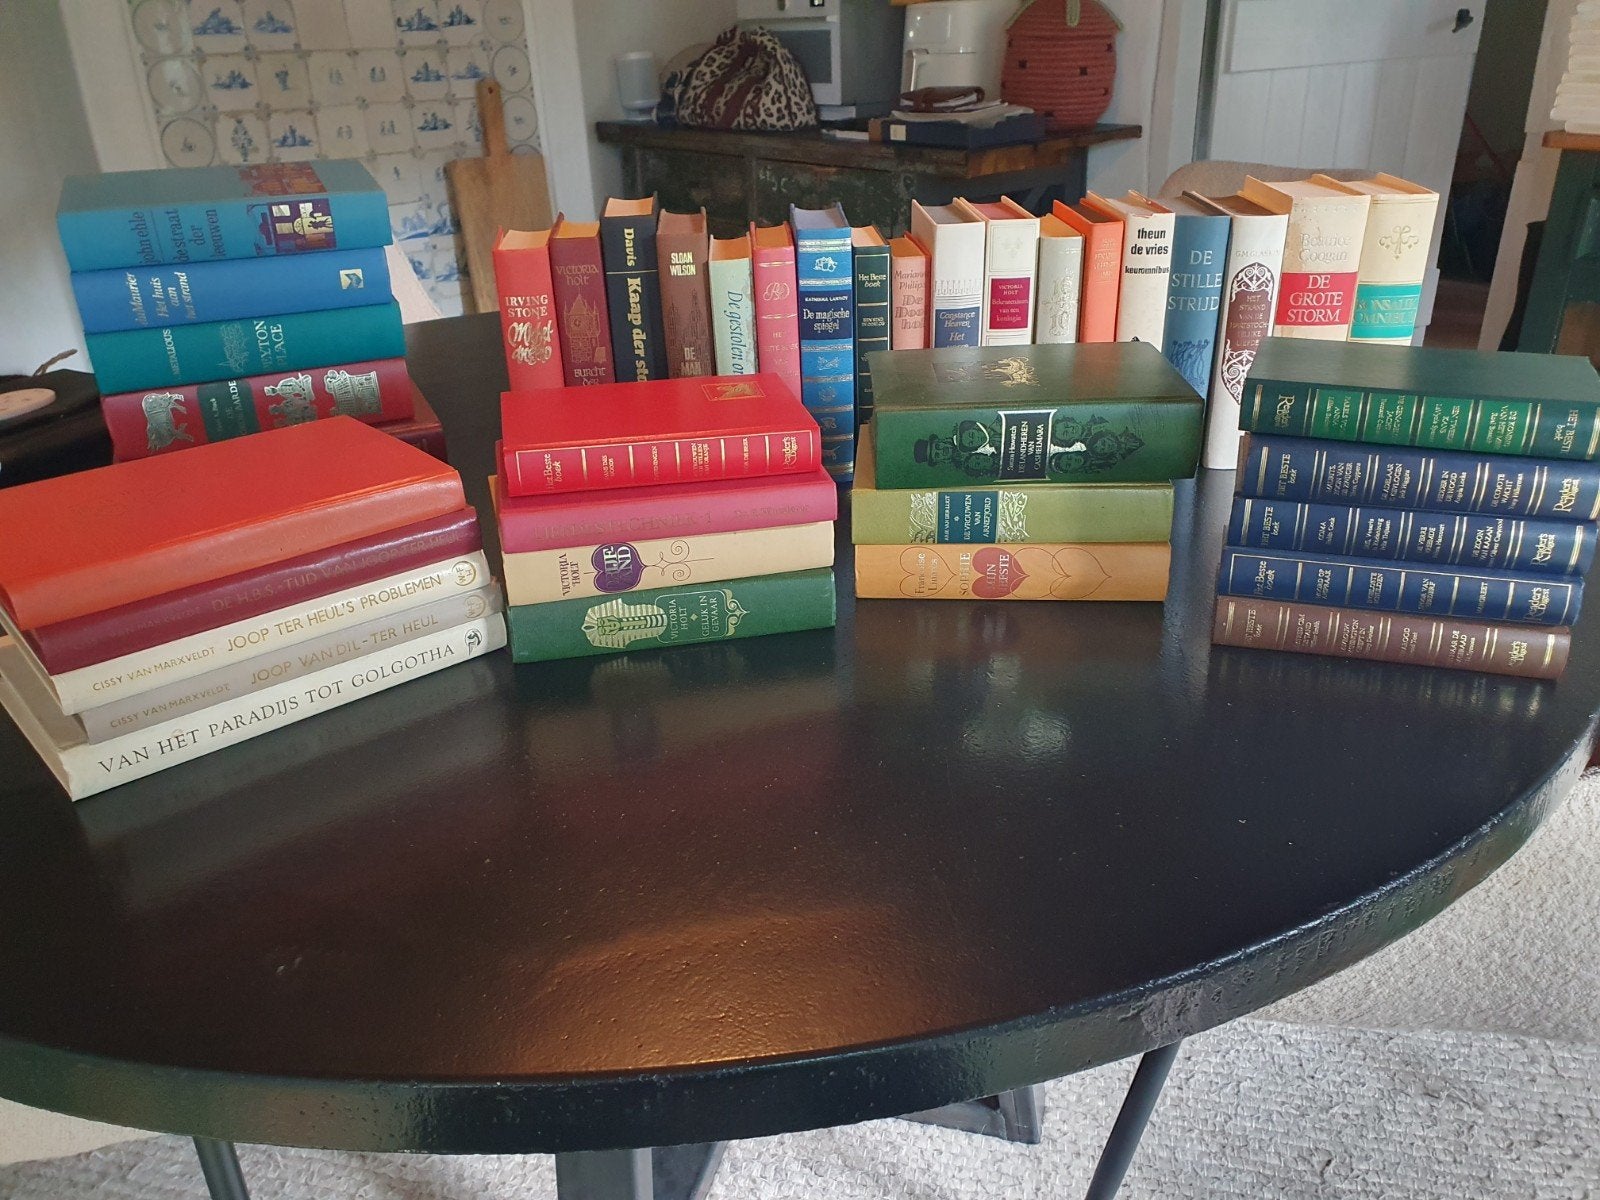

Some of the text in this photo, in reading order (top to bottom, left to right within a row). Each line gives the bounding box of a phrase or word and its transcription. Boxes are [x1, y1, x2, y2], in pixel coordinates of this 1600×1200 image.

[127, 211, 151, 238] ehle
[165, 208, 184, 248] straat
[189, 224, 206, 246] der
[203, 209, 228, 259] leeuwen
[1137, 228, 1166, 240] theun
[624, 227, 636, 267] Davis
[1130, 243, 1169, 256] de vries
[1298, 249, 1349, 265] Coogan
[671, 252, 694, 264] SLOAN
[1190, 250, 1213, 266] DE
[670, 264, 697, 277] WILSON
[858, 272, 888, 281] Het Beste
[1124, 265, 1170, 276] keuromnibus
[149, 277, 164, 300] huis
[174, 271, 193, 303] strand
[864, 279, 882, 288] boek
[998, 283, 1025, 291] VICTORIA
[1171, 273, 1222, 290] STILLE
[1307, 275, 1331, 290] DE
[166, 286, 180, 307] aan
[505, 294, 549, 307] IRVING
[626, 277, 643, 326] Kaap
[902, 294, 924, 306] De
[1168, 295, 1220, 312] STRIJD
[1289, 291, 1345, 307] GROTE
[507, 306, 548, 320] STONE
[803, 305, 851, 321] De magische
[939, 310, 976, 322] Constance
[1286, 309, 1341, 323] STORM
[723, 290, 747, 361] De gestolen
[813, 318, 840, 334] spiegel
[950, 331, 966, 341] Het
[269, 323, 287, 368] PLACE
[632, 324, 647, 357] der
[684, 347, 697, 361] DE
[681, 360, 701, 376] MAN
[1567, 409, 1580, 428] HET
[1018, 420, 1029, 464] LANDHEREN
[1553, 423, 1565, 442] boek
[1027, 440, 1035, 456] VAN
[1034, 423, 1045, 470] CASHELMARA
[542, 452, 553, 476] Beste
[553, 460, 563, 483] boek
[1278, 453, 1291, 480] BESTE
[1288, 468, 1298, 485] boek
[1447, 472, 1458, 493] NOOD
[1500, 479, 1514, 504] WACHT
[963, 494, 973, 541] DE VROUWEN
[974, 511, 982, 526] VAN
[982, 496, 993, 538] ARNEFJORD
[1262, 506, 1274, 532] BESTE
[1271, 520, 1281, 537] boek
[1317, 520, 1327, 541] COMA
[1473, 528, 1484, 549] ZOON
[1481, 525, 1494, 549] KAZAN
[558, 552, 571, 597] VICTORIA
[569, 561, 580, 587] HOLT
[1254, 560, 1267, 582] Beste
[1265, 568, 1276, 591] boek
[669, 598, 678, 641] VICTORIA
[680, 605, 688, 631] HOLT
[699, 594, 710, 638] GELUK IN
[711, 596, 720, 632] GEVAAR
[92, 573, 442, 692] CISSY VAN MARXVELDT JOOP TER HEUL'S PROBLEMEN
[109, 712, 140, 729] CISSY
[142, 703, 168, 718] VAN
[168, 682, 231, 712] MARXVELDT
[251, 660, 292, 685] JOOP
[299, 649, 333, 668] VAN
[403, 615, 439, 635] HEUL
[98, 643, 456, 775] VAN HET PARADIJS TOT GOLGOTHA
